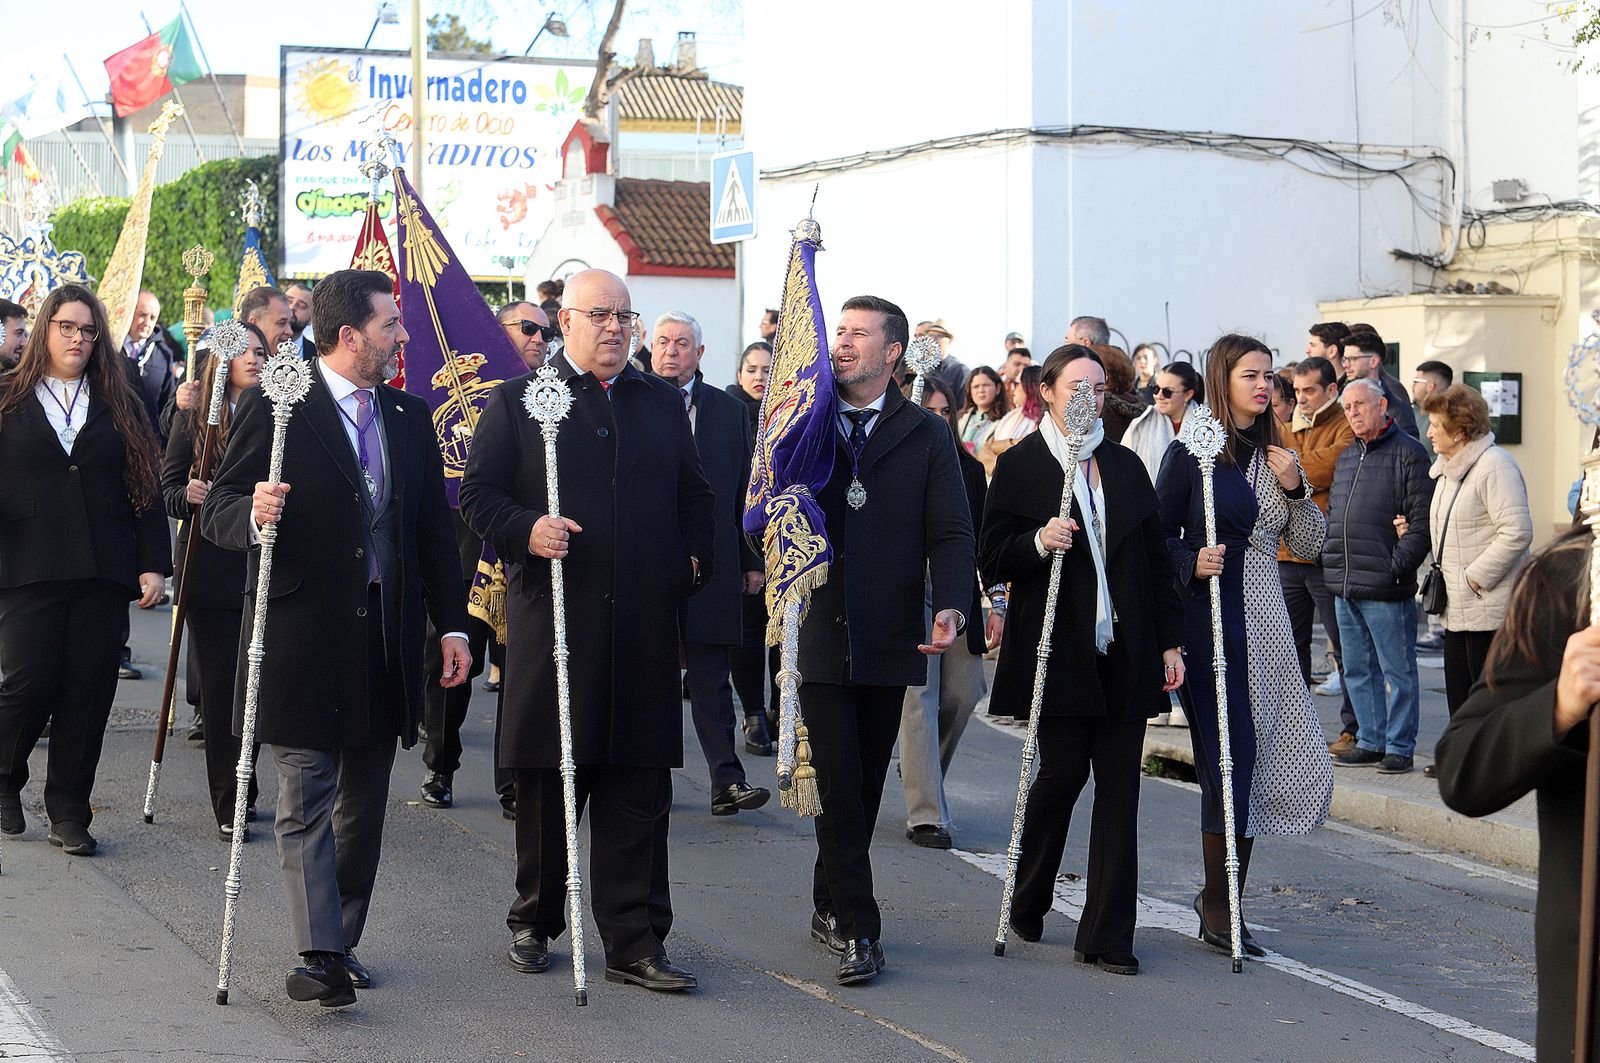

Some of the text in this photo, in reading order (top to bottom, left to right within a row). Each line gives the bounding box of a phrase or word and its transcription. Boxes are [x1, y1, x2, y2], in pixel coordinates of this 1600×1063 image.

[383, 105, 514, 135] Cero de Ocio
[343, 140, 537, 169] MNADITOS
